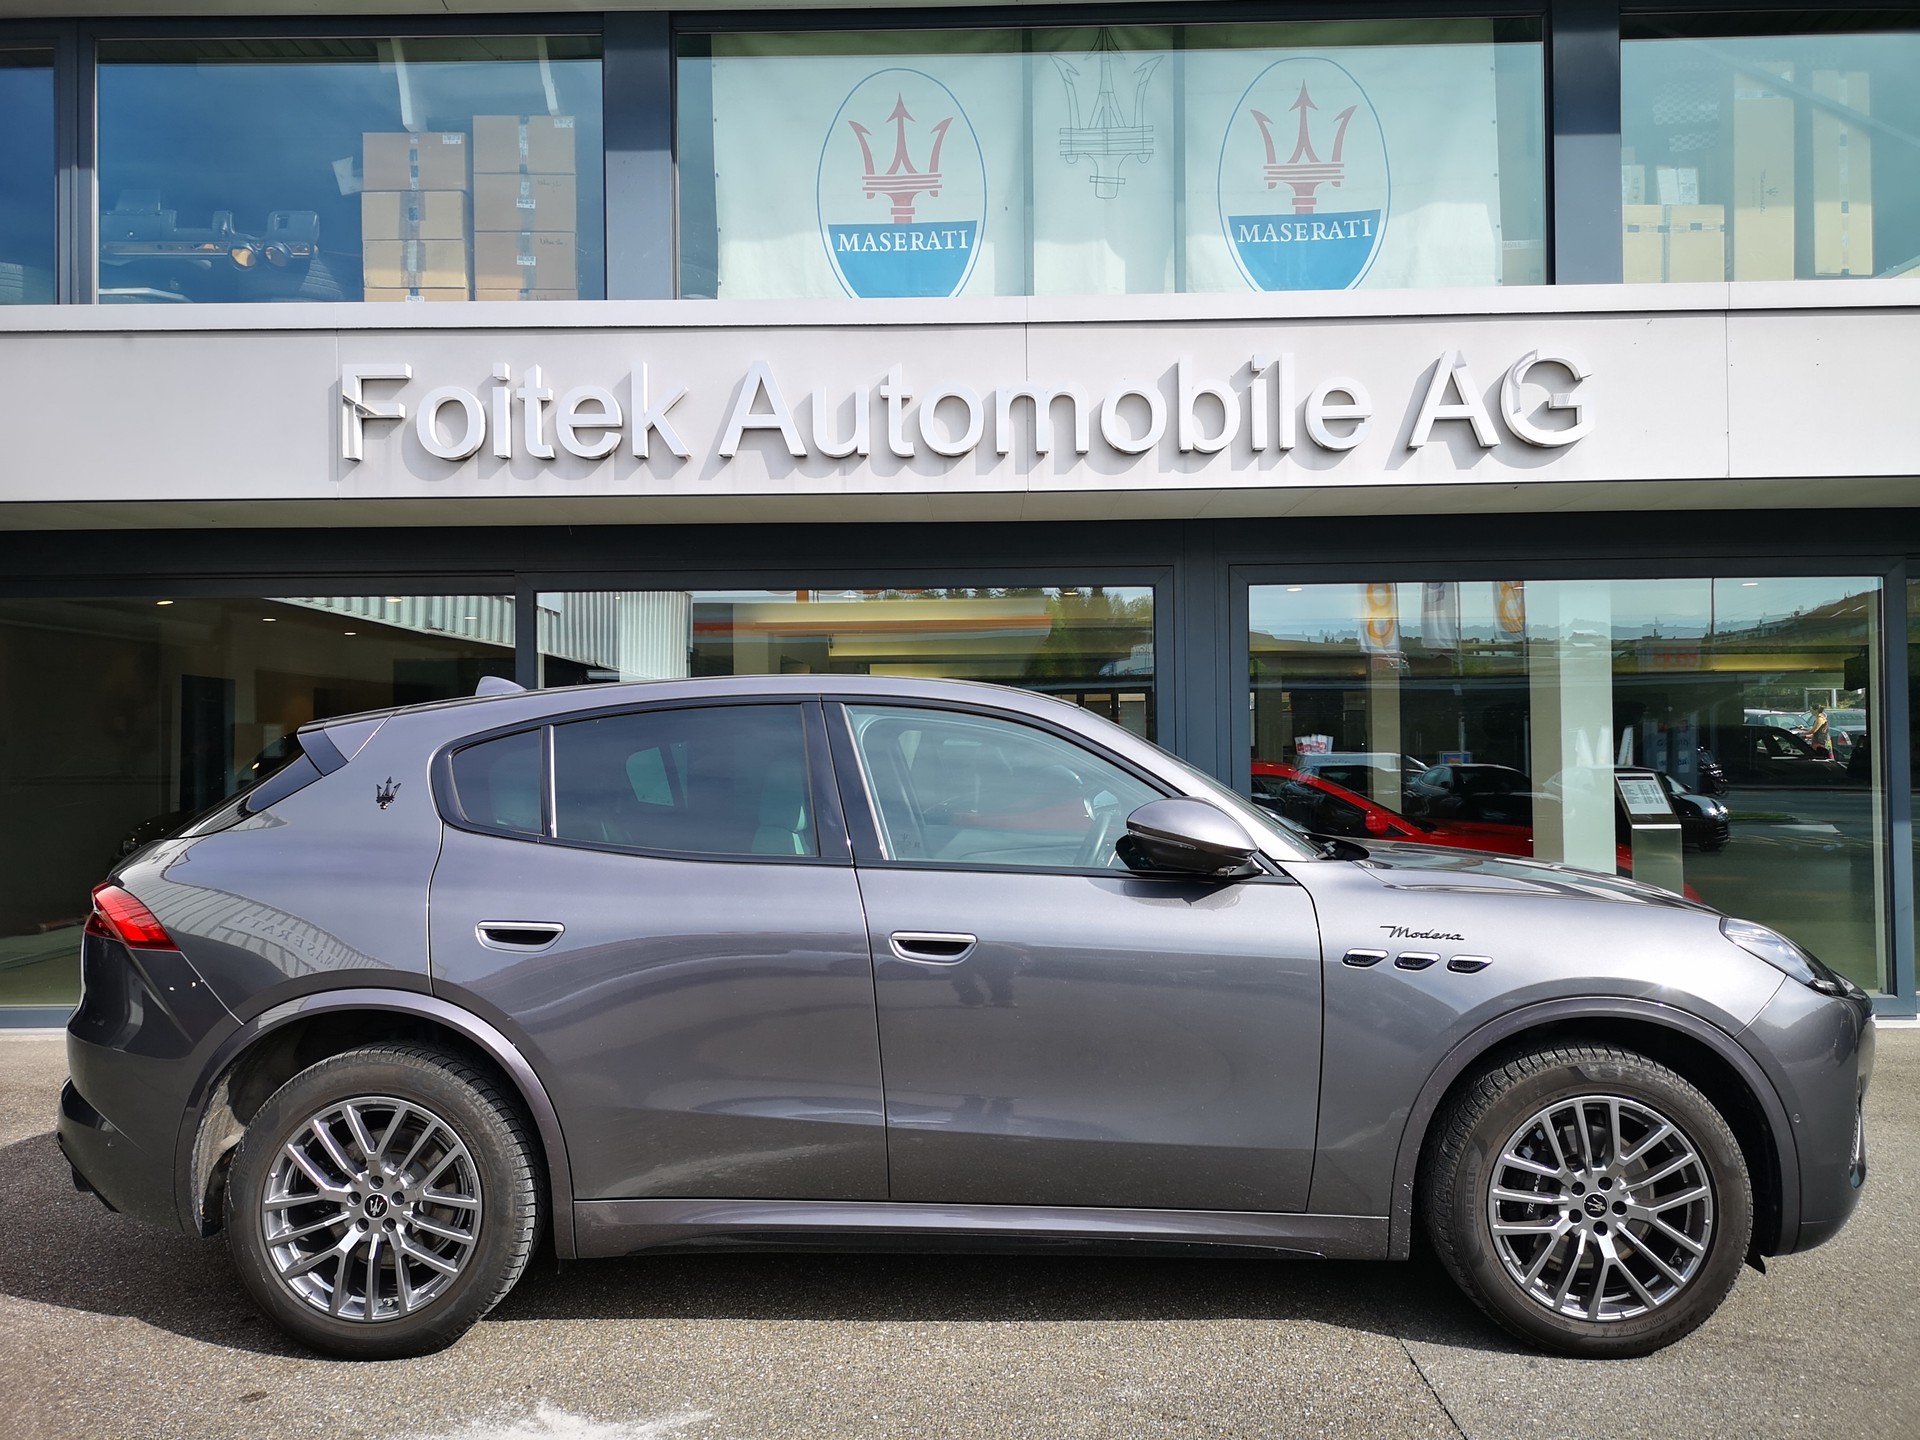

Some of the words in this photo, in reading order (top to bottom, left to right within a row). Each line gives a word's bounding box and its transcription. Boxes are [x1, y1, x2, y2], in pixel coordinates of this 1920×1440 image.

[837, 229, 970, 254] MASERATI
[1238, 218, 1373, 244] MASERATI
[340, 360, 690, 461] Foitek
[717, 352, 1373, 460] Automobile
[1406, 349, 1593, 449] AG
[1379, 925, 1465, 942] Modena
